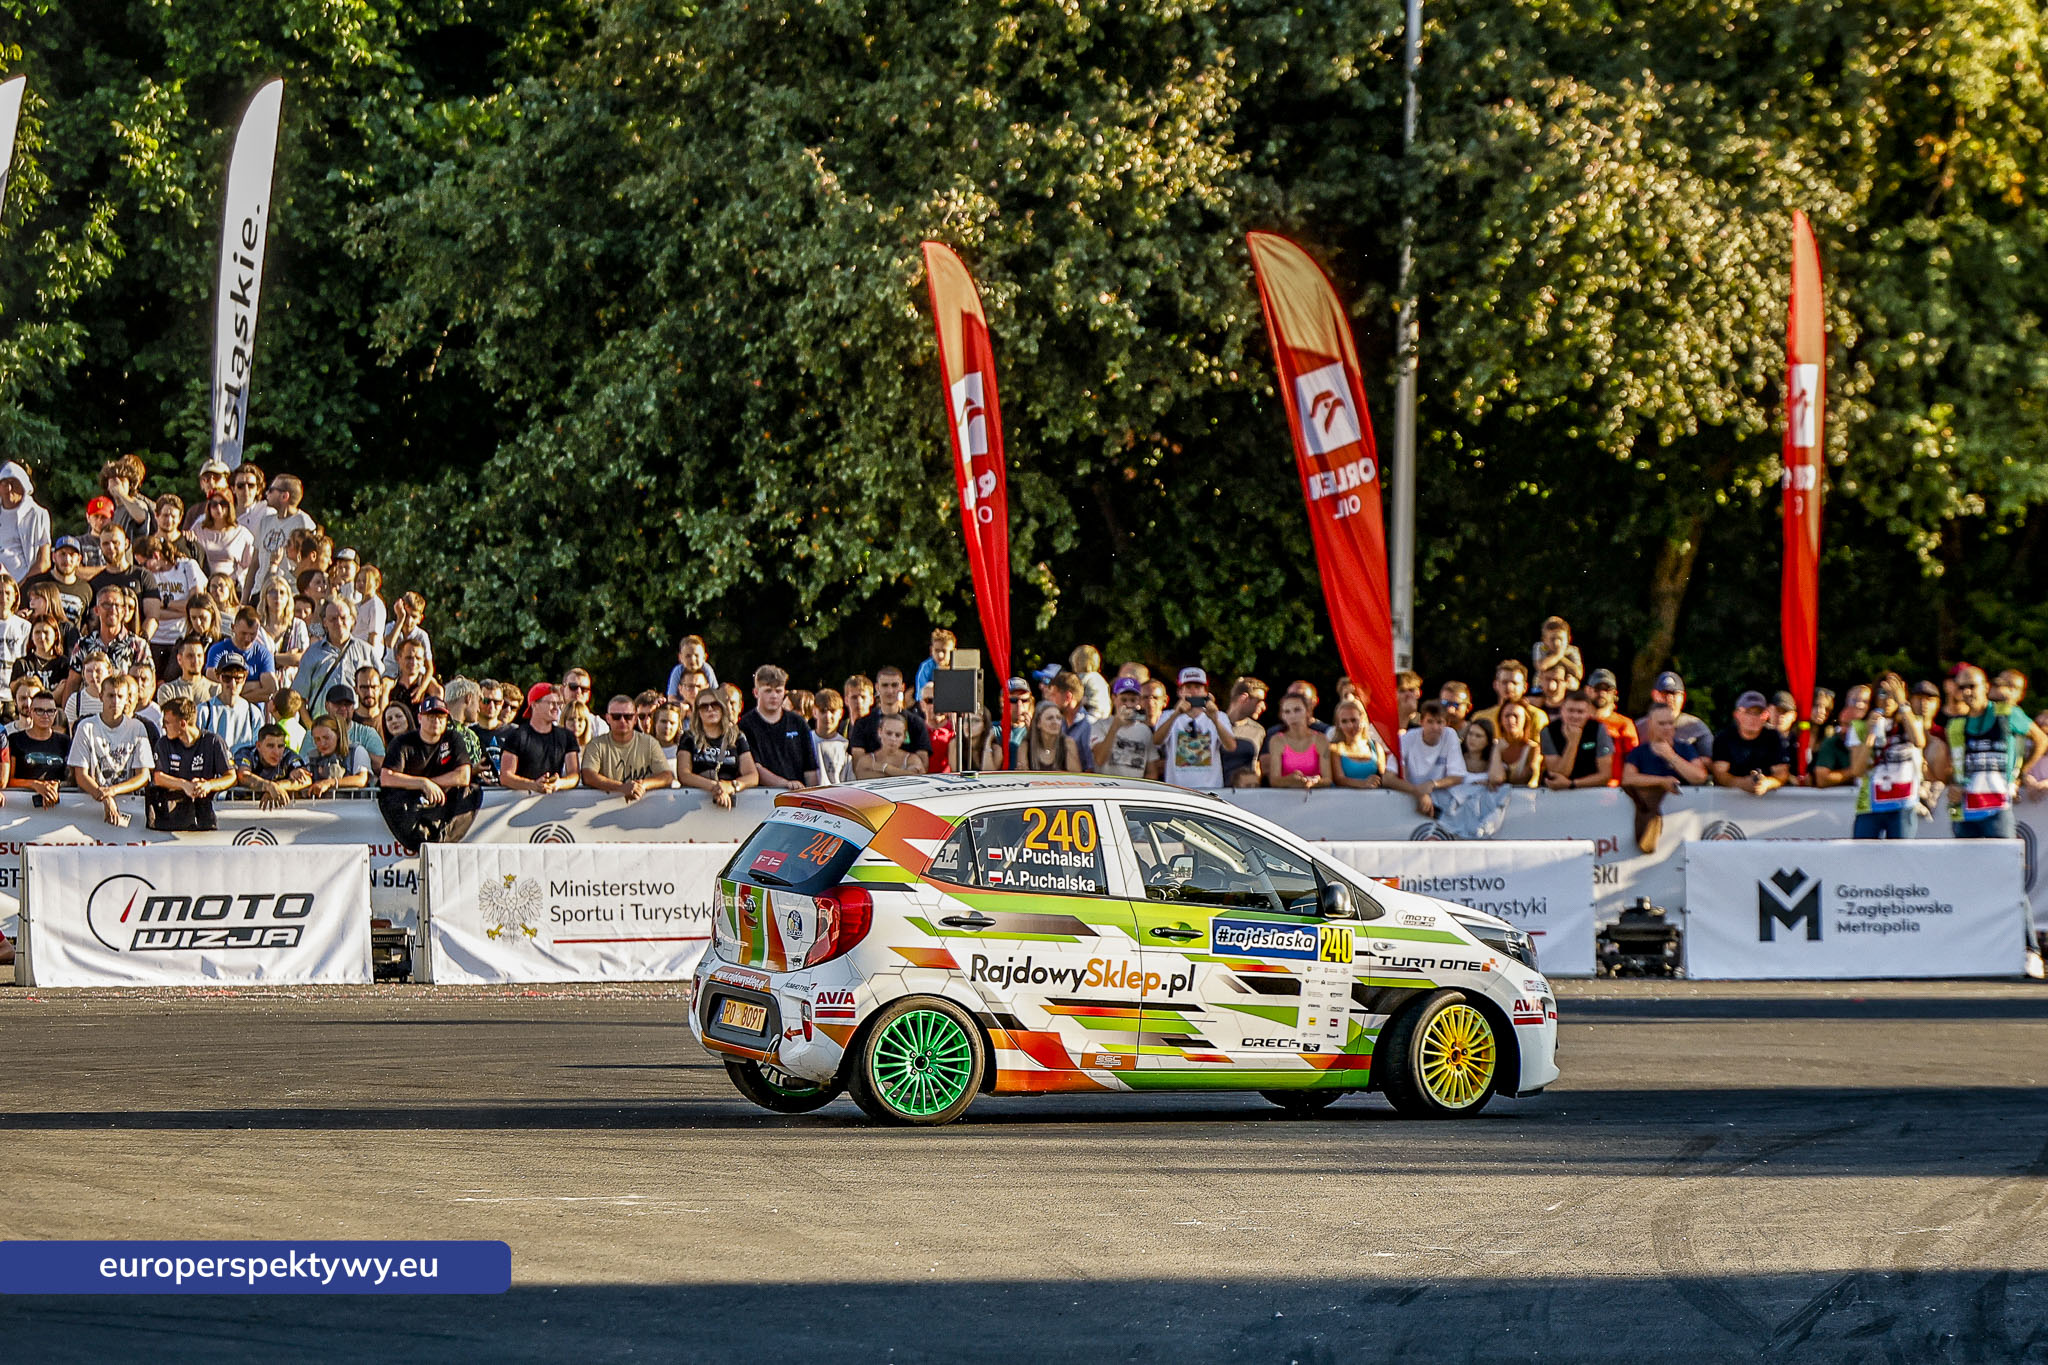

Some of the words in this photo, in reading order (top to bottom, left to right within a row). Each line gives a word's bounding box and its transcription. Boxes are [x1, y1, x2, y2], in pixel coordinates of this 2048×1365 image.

[1022, 807, 1097, 853] 240
[798, 832, 844, 866] 240
[1003, 846, 1094, 868] W.Puchalski
[384, 864, 418, 894] ŚLĄ
[550, 880, 674, 897] Ministerstwo
[1004, 870, 1096, 892] A.Puchalska
[1401, 875, 1505, 892] inisterstwo
[1836, 883, 1930, 900] Górnośląsko
[140, 894, 314, 921] MOTO
[550, 905, 613, 925] Sportu
[620, 904, 625, 920] i
[631, 902, 712, 923] Turystyk
[135, 927, 298, 949] WIZJA
[1837, 919, 1920, 935] Metropolia
[1320, 927, 1353, 963] 240
[1379, 955, 1436, 968] TURN
[1439, 959, 1481, 971] ONE
[970, 954, 1197, 998] RajdowySklep.pl
[741, 1006, 765, 1029] 809T
